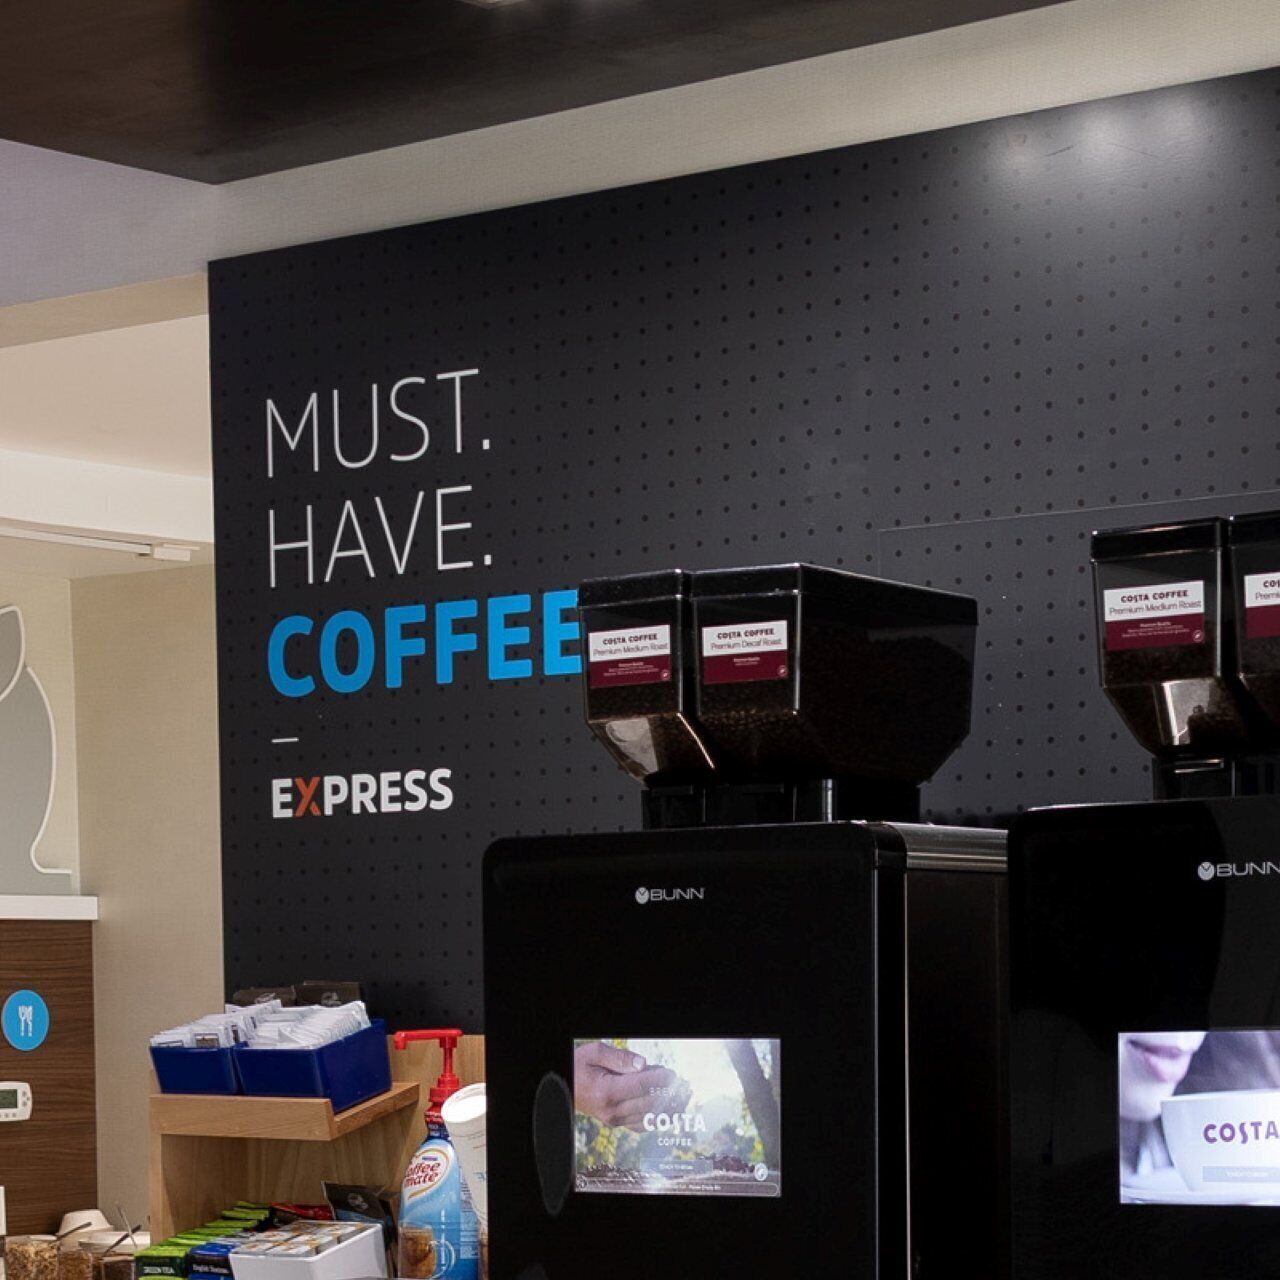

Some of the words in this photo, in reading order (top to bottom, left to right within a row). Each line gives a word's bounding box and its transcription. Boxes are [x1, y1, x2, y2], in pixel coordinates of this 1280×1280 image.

[265, 367, 492, 479] MUST.
[268, 485, 493, 588] HAVE.
[1120, 594, 1149, 603] COSTA
[1151, 589, 1189, 600] COFFEE
[1108, 606, 1144, 616] Premium
[1144, 602, 1178, 613] Medium
[1178, 600, 1202, 609] Roast
[267, 589, 583, 698] COFFEE
[603, 637, 627, 646] COSTA
[629, 633, 658, 643] COFFEE
[717, 631, 742, 640] COSTA
[744, 628, 775, 637] COFFEE
[271, 768, 454, 818] EXPRESS
[650, 887, 705, 901] BUNN
[642, 1112, 706, 1135] COSTA
[1203, 1120, 1280, 1144] COSTA
